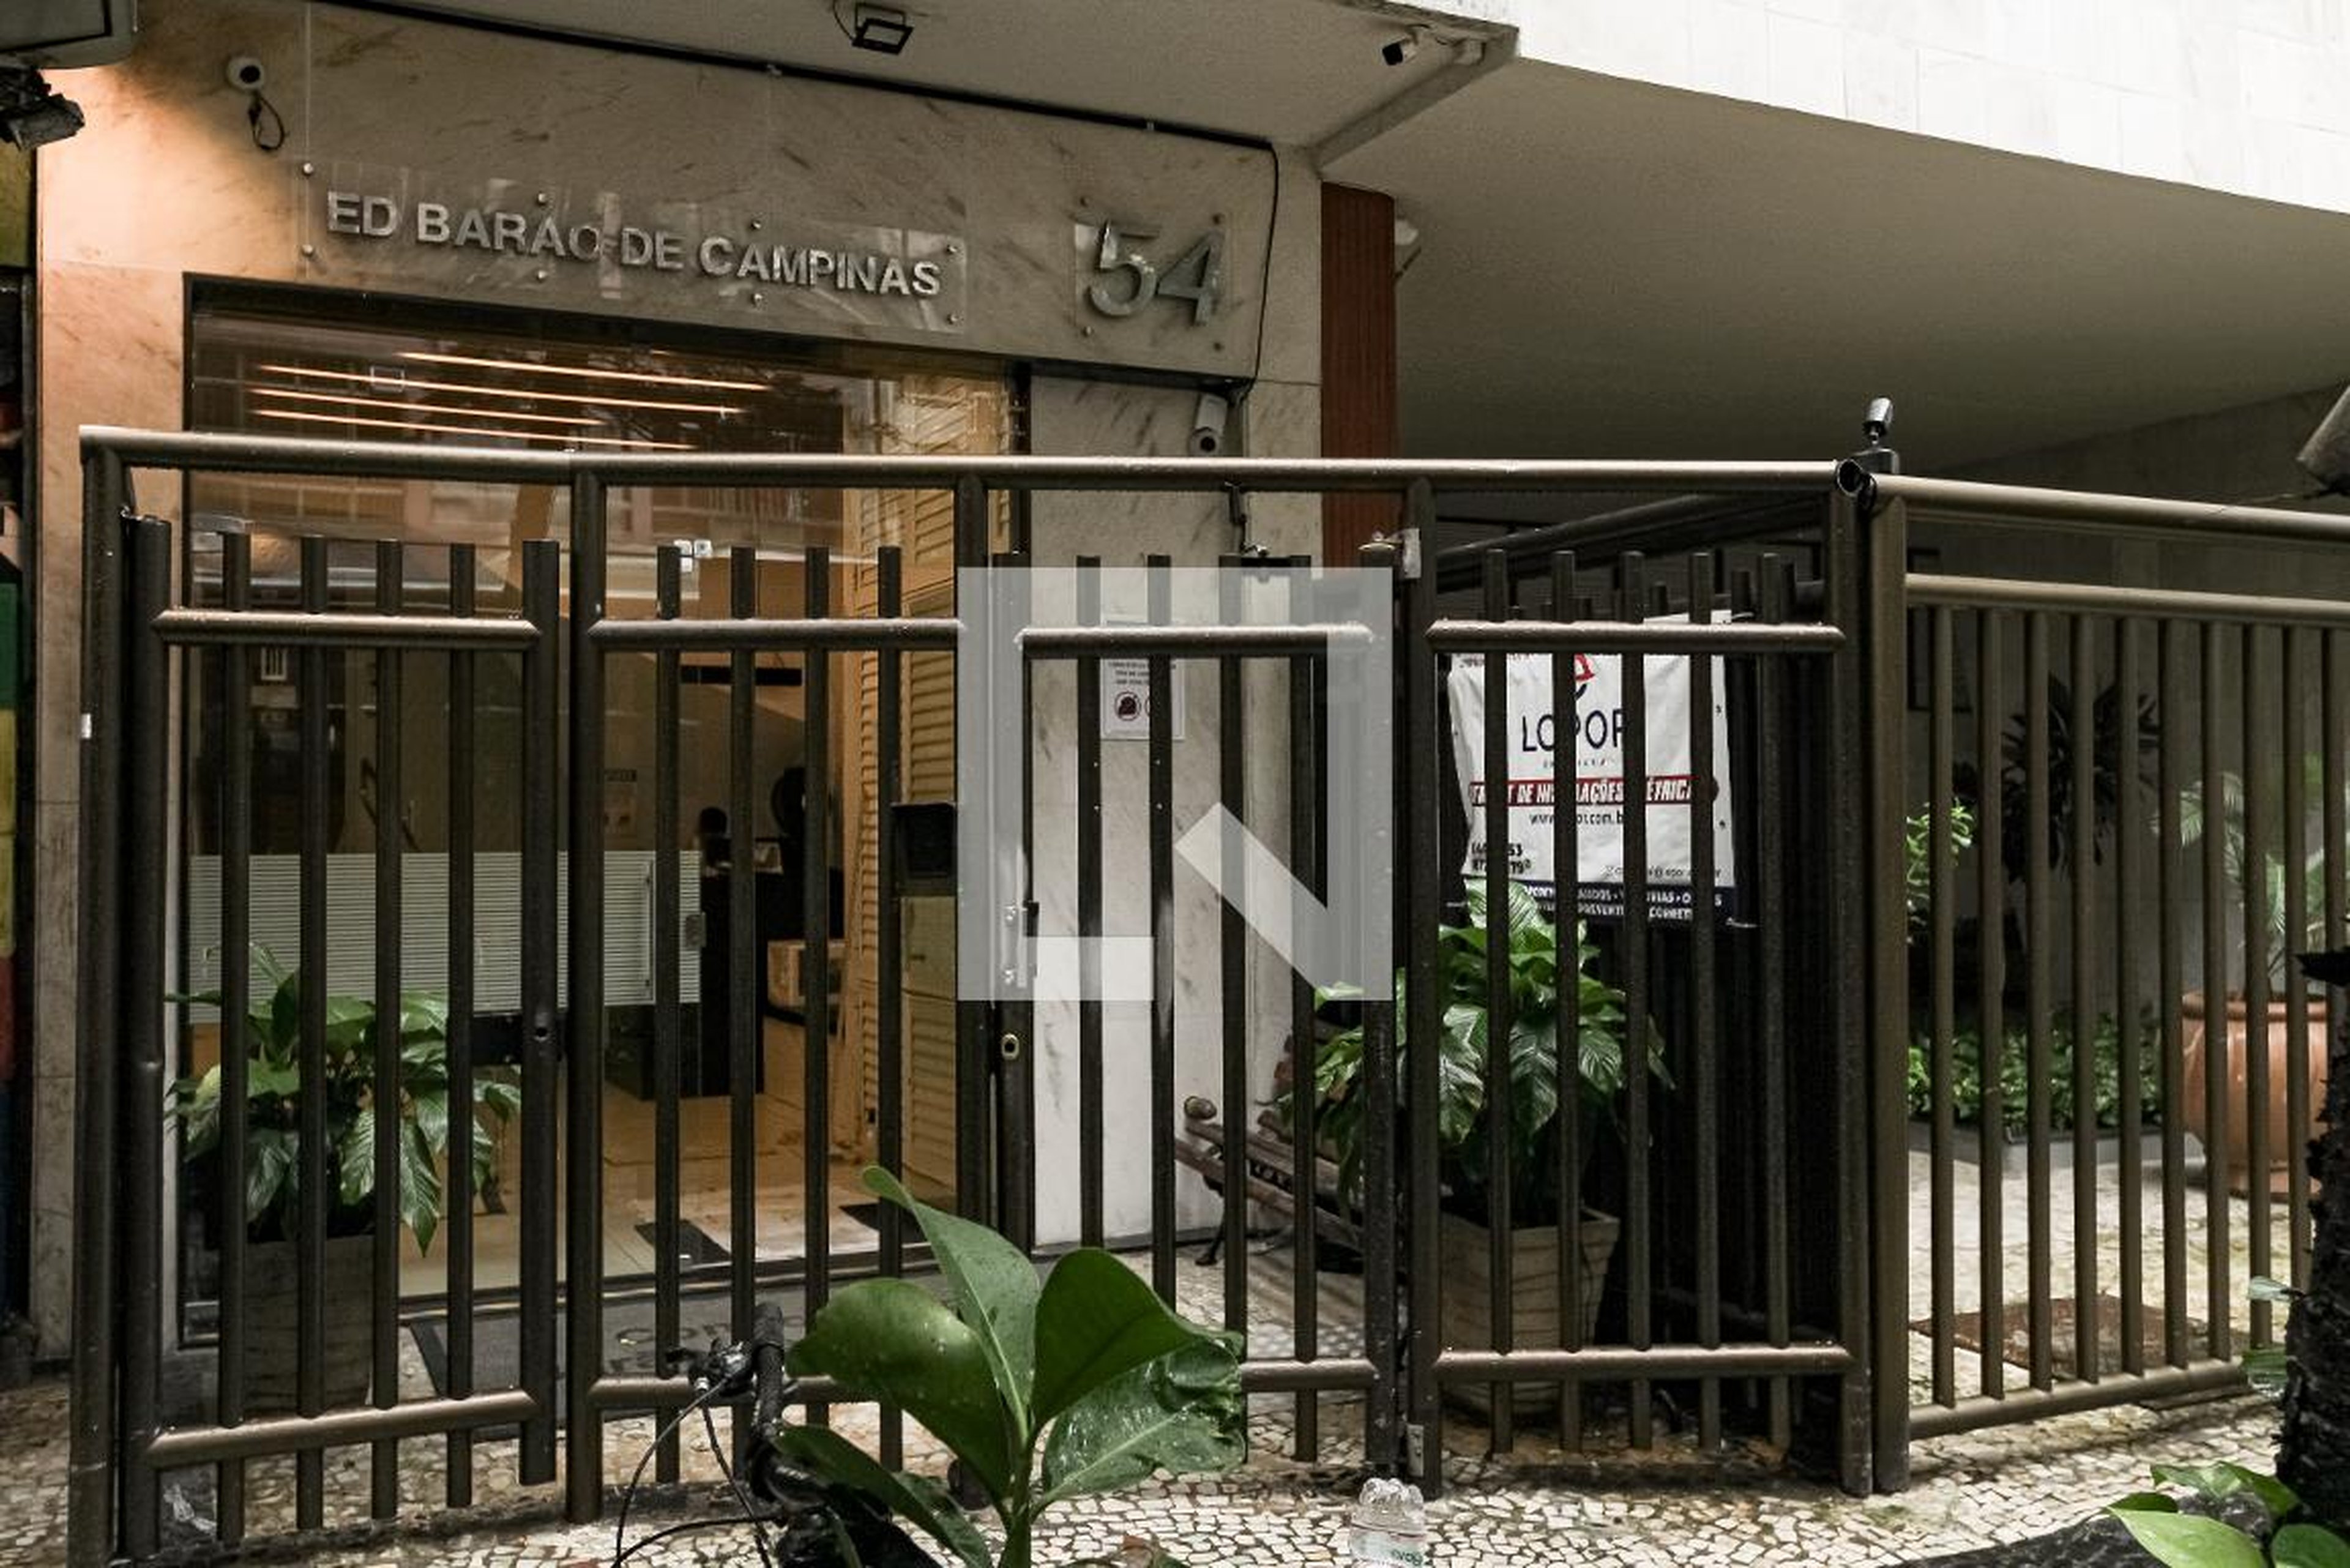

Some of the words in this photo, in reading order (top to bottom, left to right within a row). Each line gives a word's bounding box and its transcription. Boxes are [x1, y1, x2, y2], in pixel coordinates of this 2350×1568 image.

[327, 191, 398, 237] ED
[621, 228, 685, 269] DE
[700, 236, 941, 295] CAMPINAS
[1086, 222, 1225, 327] 54
